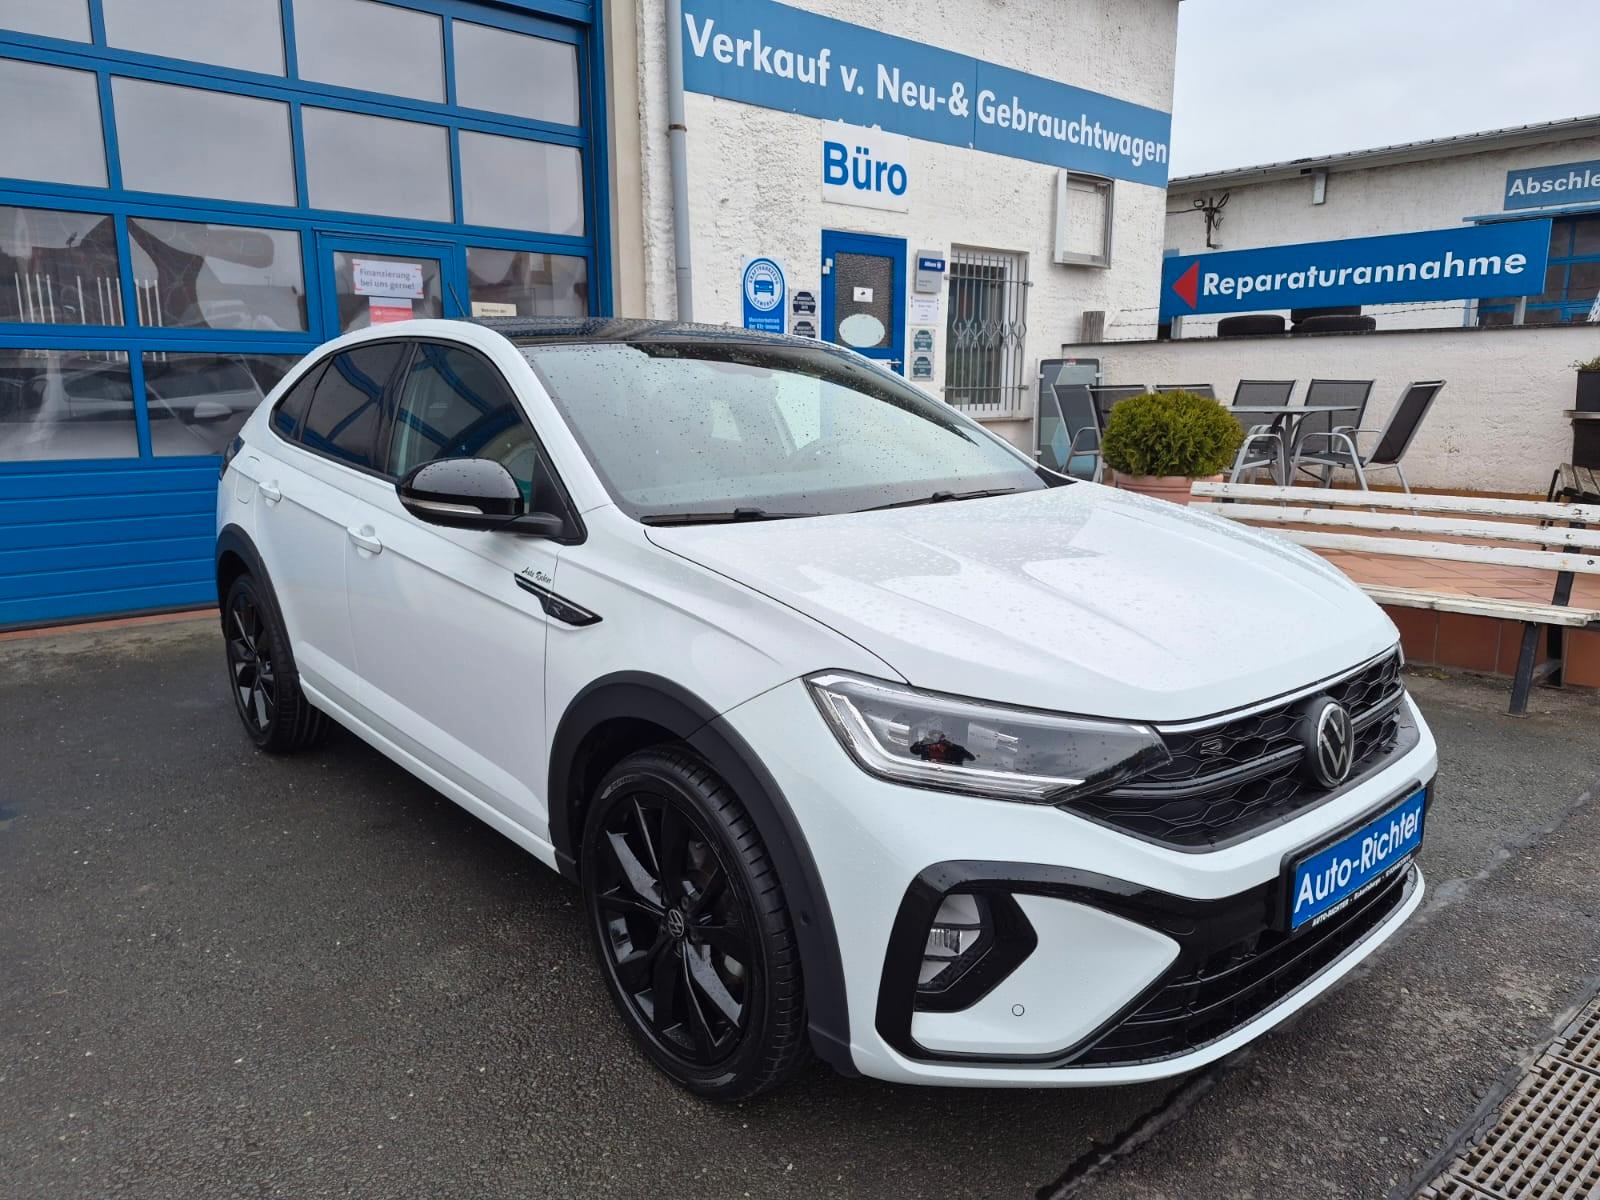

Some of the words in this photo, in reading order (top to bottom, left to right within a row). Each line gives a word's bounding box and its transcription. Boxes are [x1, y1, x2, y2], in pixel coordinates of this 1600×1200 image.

[685, 13, 830, 87] Verkauf
[840, 64, 864, 95] v.
[976, 90, 1167, 166] Gebrauchtwagen
[823, 141, 907, 196] Büro
[359, 267, 411, 281] Finanzierung
[360, 279, 374, 287] bei
[374, 281, 389, 289] uns
[390, 281, 415, 290] gerne!
[1202, 251, 1527, 300] Reparaturannahme
[1294, 805, 1421, 914] Auto-Richter
